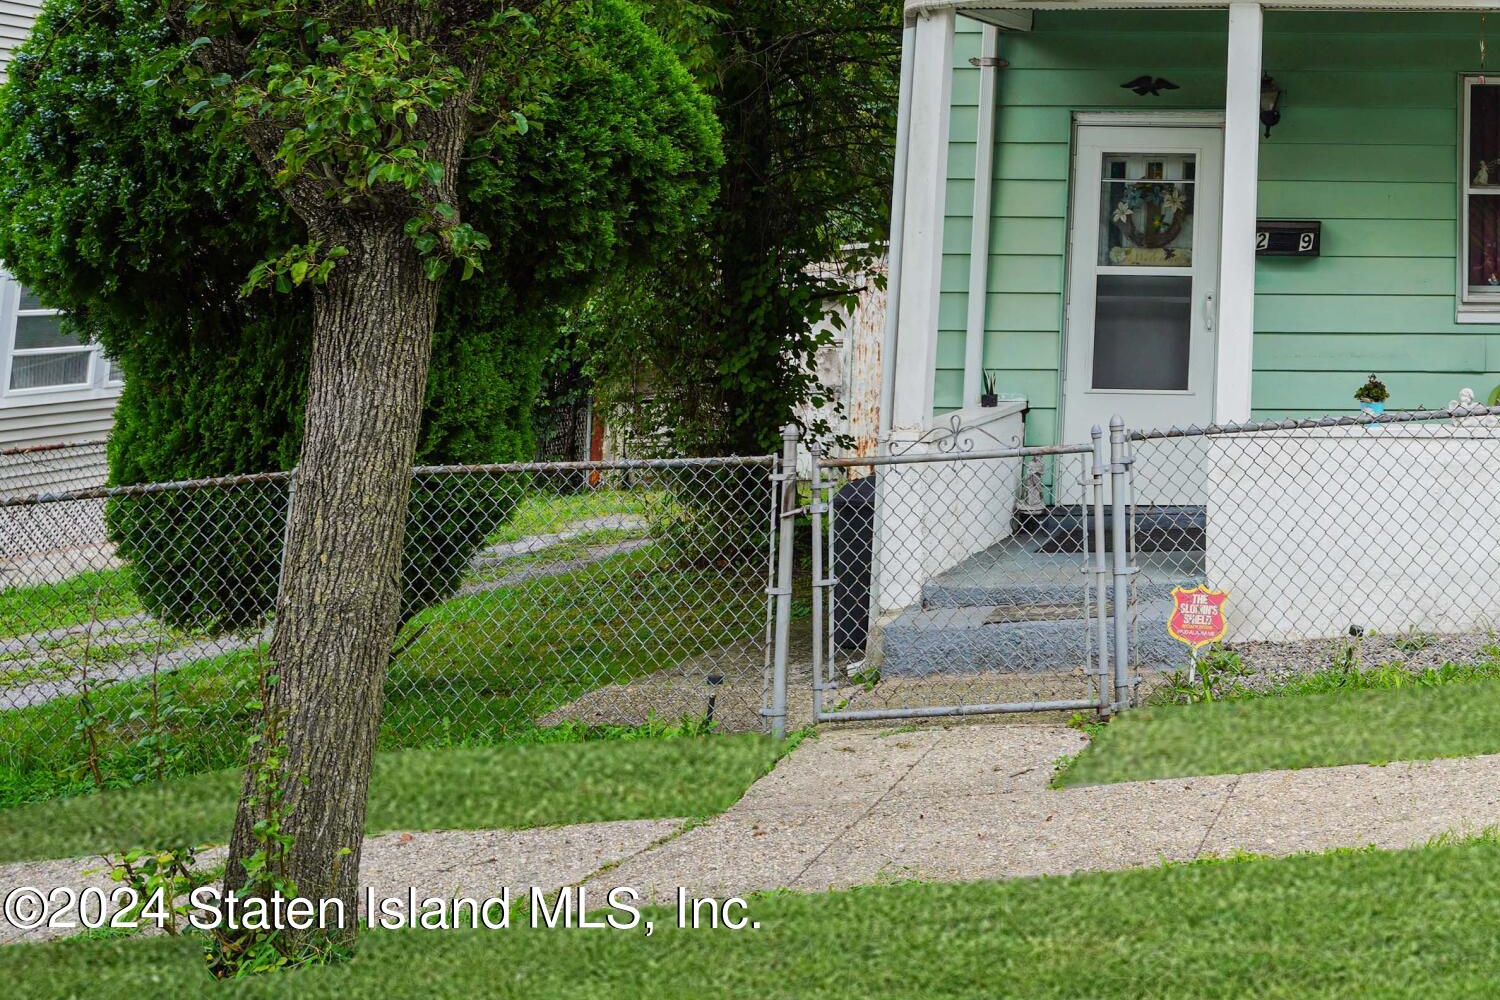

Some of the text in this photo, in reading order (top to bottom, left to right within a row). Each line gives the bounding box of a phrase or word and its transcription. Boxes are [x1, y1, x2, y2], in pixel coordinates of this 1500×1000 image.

[1256, 233, 1312, 249] 2 9
[1192, 594, 1208, 605] THE
